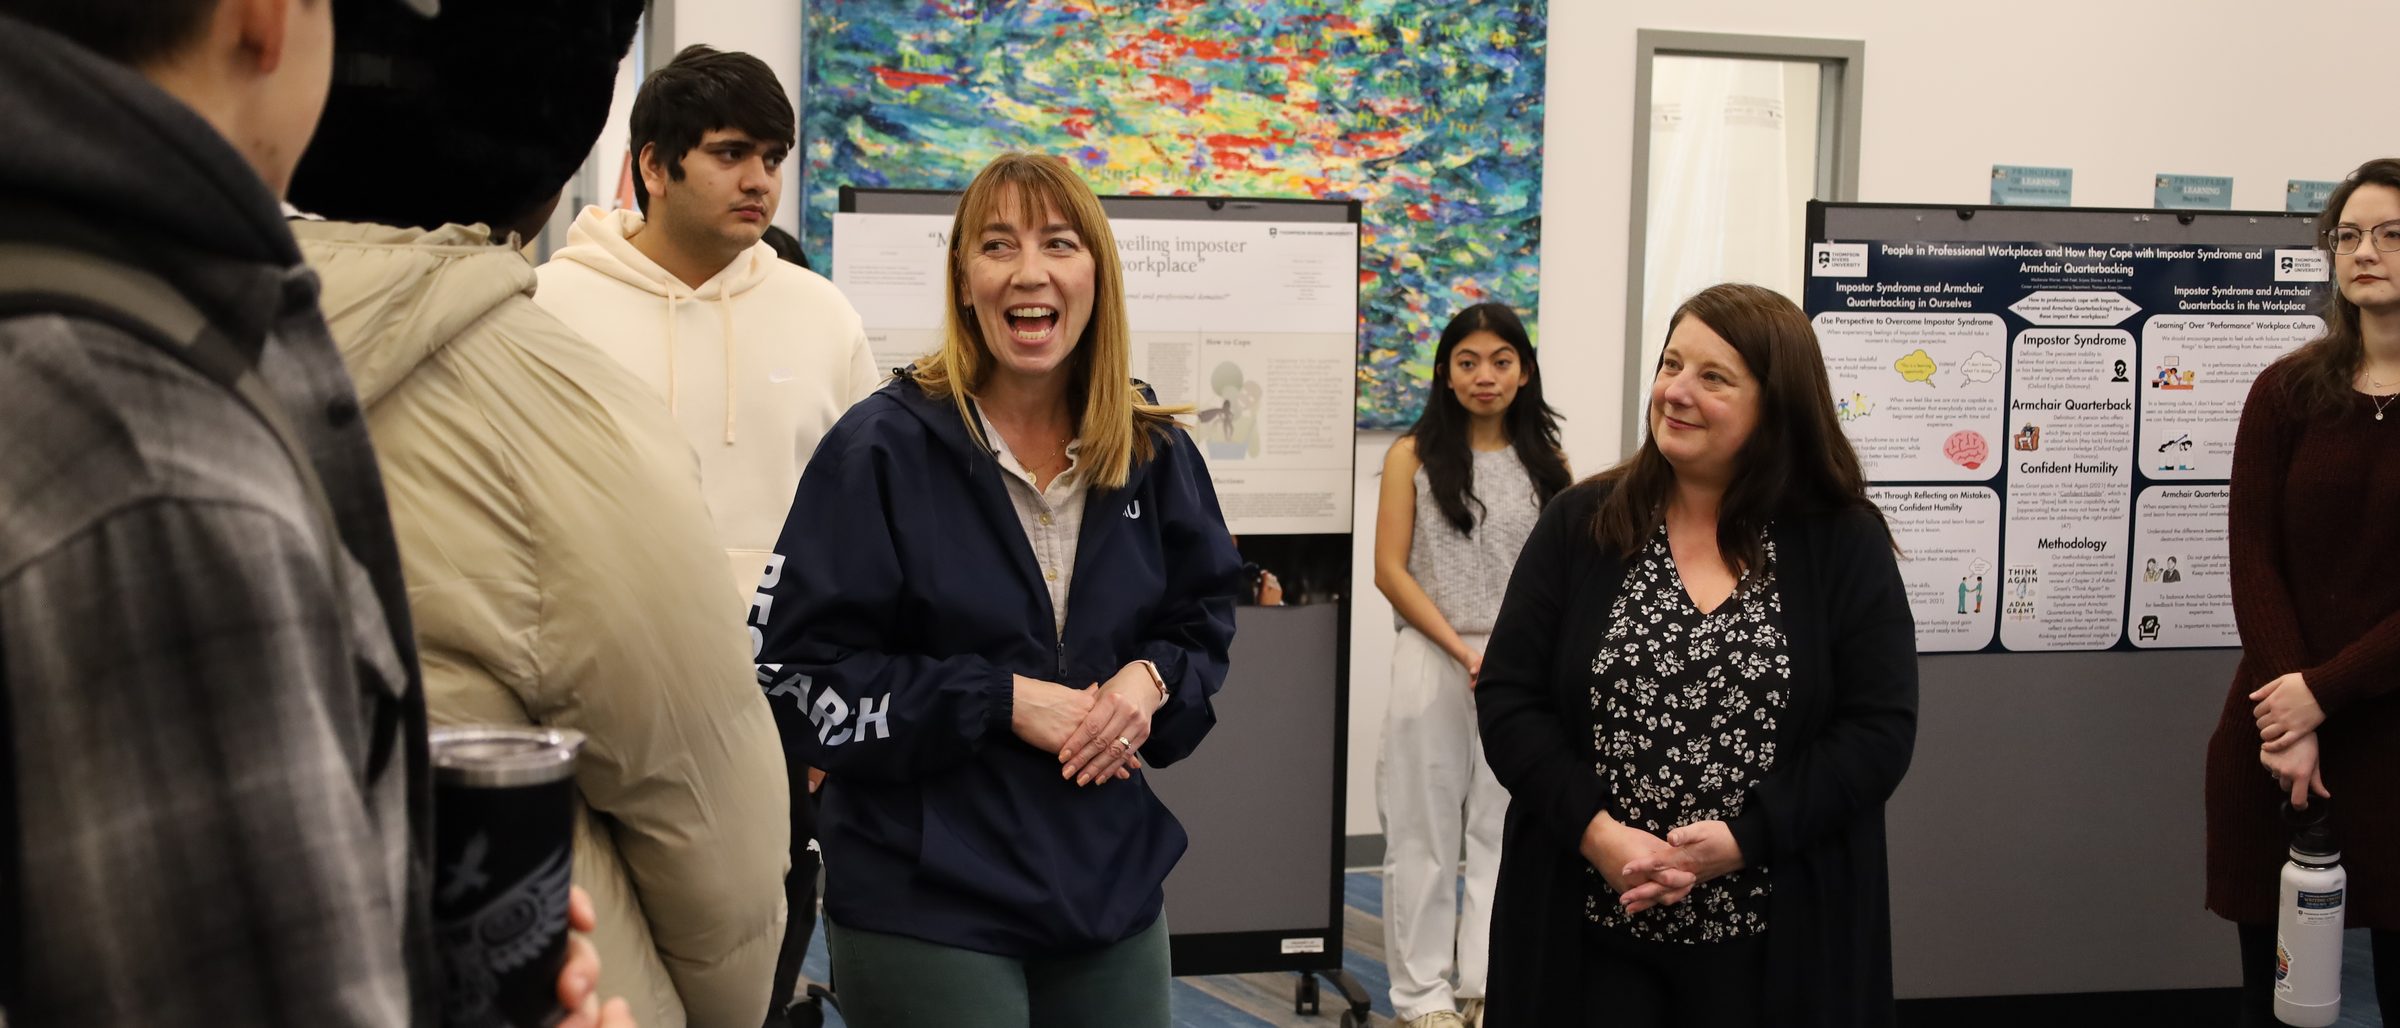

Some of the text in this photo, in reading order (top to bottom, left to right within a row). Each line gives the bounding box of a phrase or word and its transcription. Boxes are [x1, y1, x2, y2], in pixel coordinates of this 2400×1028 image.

[2022, 177, 2060, 186] LEARNING
[2183, 186, 2221, 195] LEARNING
[1118, 235, 1248, 259] veiling imposter
[1882, 245, 2262, 262] People in Professional Workplaces and How they Cope with Impostor Syndrome and
[2020, 263, 2134, 276] Armchair Quarterbacking
[1836, 282, 1984, 294] Impostor Syndrome and Armchair
[2174, 286, 2311, 297] Impostor Syndrome and Armchair
[1847, 297, 1972, 310] Quarterbacking in Ourselves
[2179, 300, 2306, 312] Quarterbacks in the Workplace
[1836, 318, 1876, 326] Perspective
[1925, 318, 1956, 327] Impostor
[1957, 318, 1993, 327] Syndrome
[2154, 322, 2188, 330] “Learning”
[2256, 322, 2291, 330] Workplace
[2024, 334, 2126, 348] Impostor Syndrome
[2012, 398, 2131, 410] Armchair Quarterback
[2021, 462, 2118, 476] Confident Humility
[1884, 491, 1913, 501] Through
[1915, 491, 1949, 501] Reflecting
[1934, 504, 1962, 513] Humility
[2038, 537, 2107, 552] Methodology
